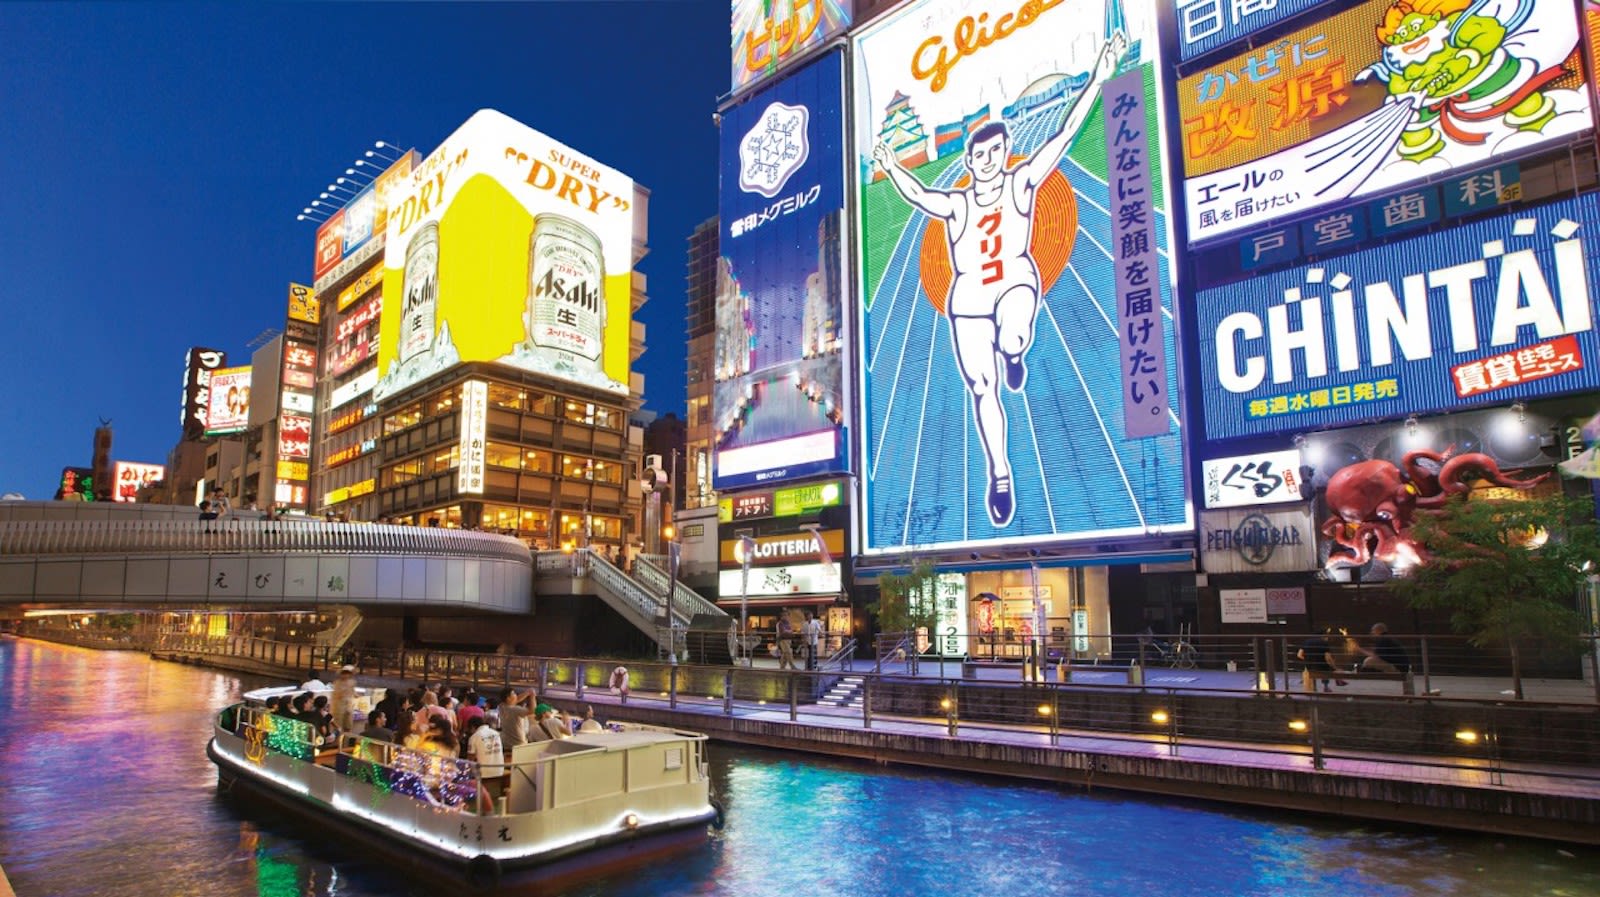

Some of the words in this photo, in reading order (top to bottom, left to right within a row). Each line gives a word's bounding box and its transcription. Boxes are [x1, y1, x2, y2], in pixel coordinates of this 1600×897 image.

[911, 0, 1065, 93] Glico
[1196, 33, 1328, 104] かぜに
[1184, 54, 1350, 160] 改源
[548, 148, 601, 182] SUPER
[1198, 169, 1284, 205] エールの
[1502, 186, 1520, 201] 3F
[1199, 191, 1301, 229] 風を届けたい
[976, 205, 1004, 286] グリコ
[1111, 92, 1161, 416] みんなに笑顔を届けたい。
[535, 267, 598, 314] Asahi
[557, 307, 577, 327] 生
[1455, 353, 1520, 395] 賃貸
[1516, 343, 1556, 370] 住宅
[1521, 352, 1580, 379] ニュース
[1249, 378, 1399, 417] 毎週水曜日発売
[1221, 460, 1283, 498] くくる
[753, 538, 821, 558] LOTTERIA
[1271, 524, 1303, 547] BAR
